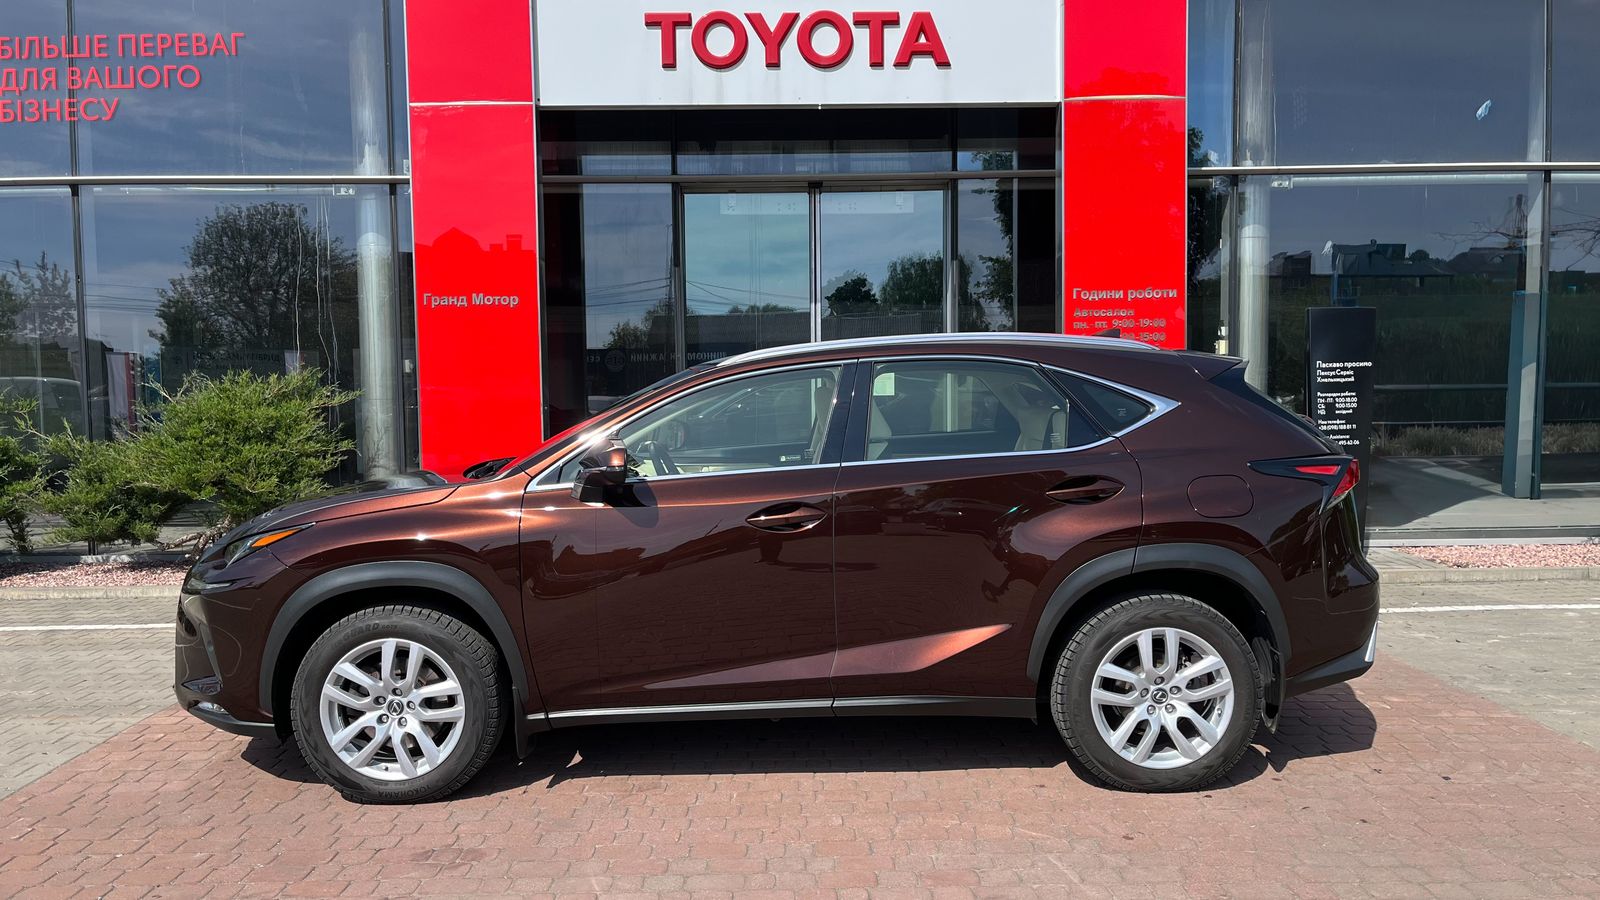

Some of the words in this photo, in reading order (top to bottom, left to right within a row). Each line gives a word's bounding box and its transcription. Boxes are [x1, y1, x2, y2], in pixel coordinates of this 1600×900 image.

[0, 34, 109, 60] БІЛЬШЕ
[117, 32, 246, 57] ПЕРЕВАГ
[644, 10, 952, 69] TOYOTA
[0, 67, 58, 95] ДЛЯ
[67, 64, 201, 90] ВАШОГО
[0, 97, 119, 123] БІЗНЕСУ
[423, 293, 468, 308] Гранд
[471, 292, 519, 308] Мотор
[1073, 287, 1124, 301] Години
[1127, 287, 1178, 301] роботи
[1073, 307, 1135, 318] Автосалон
